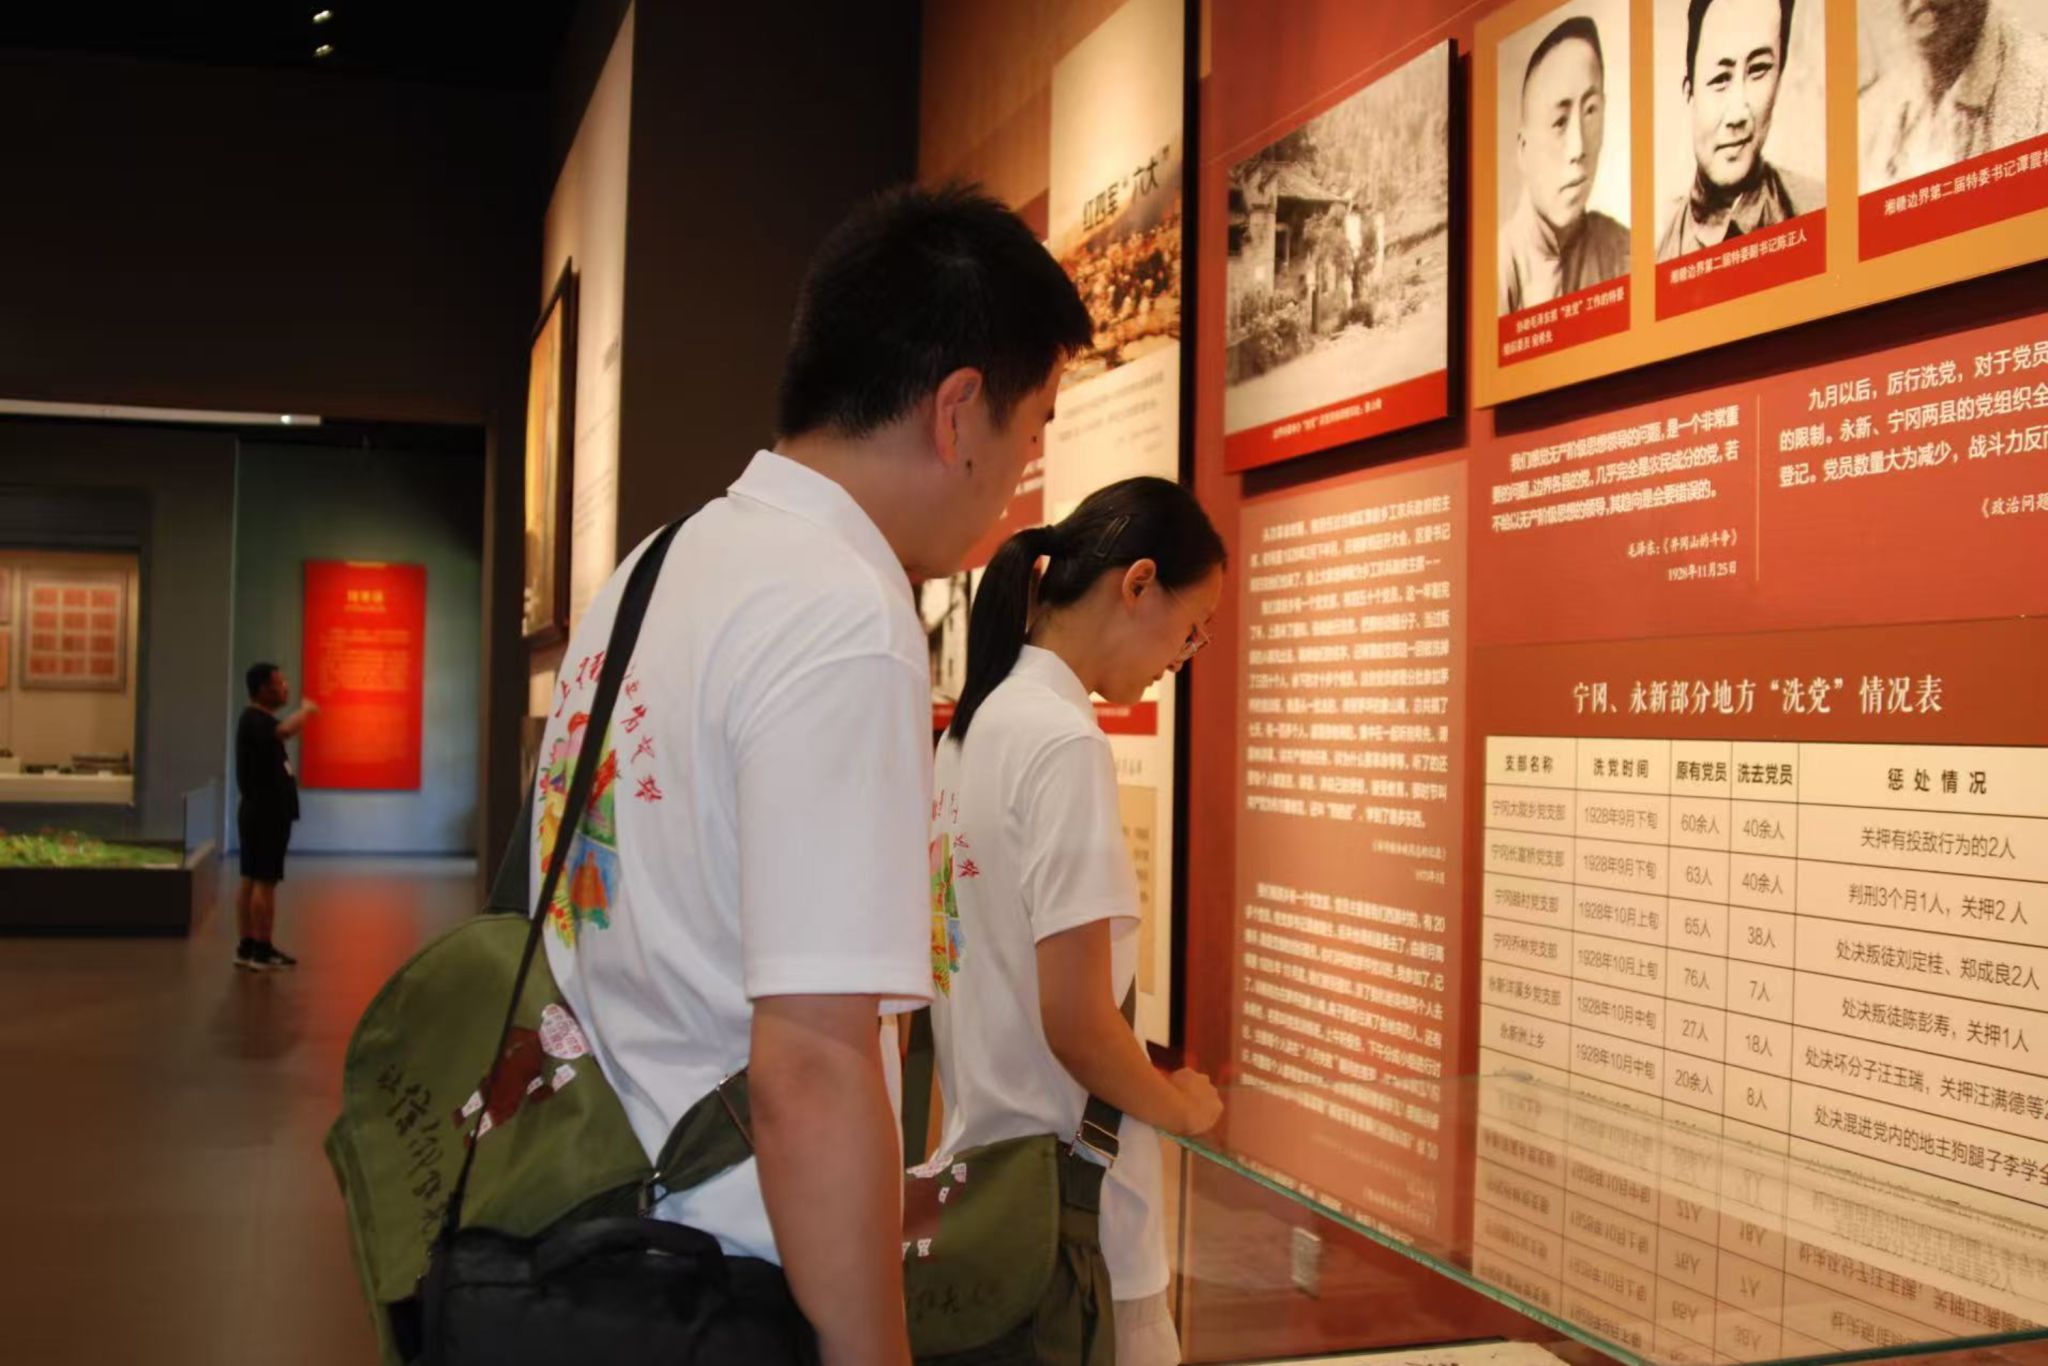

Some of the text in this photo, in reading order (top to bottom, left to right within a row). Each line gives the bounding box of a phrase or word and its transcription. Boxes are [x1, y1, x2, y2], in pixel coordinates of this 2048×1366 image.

[1808, 340, 2048, 411] 九月以后，厉行洗党，对于党员
[1779, 382, 2048, 452] 的限制。永新、宁冈两县的党组织全
[1981, 492, 2048, 518] 《政治问题
[1505, 754, 1553, 774] 支部名称
[1593, 758, 1649, 779] 洗党时间
[1676, 760, 1727, 783] 原有党员
[1737, 762, 1793, 786] 洗去党员
[1888, 768, 1987, 795] 惩处情况
[1584, 807, 1658, 830] 1928年9月下旬
[1681, 814, 1719, 835] 60余人
[1743, 819, 1785, 841] 40余人
[1861, 826, 2016, 860] 关押有投敌行为的2人
[1583, 854, 1656, 880] 1928年9月下旬
[1686, 866, 1712, 886] 63人
[1741, 873, 1783, 895] 40余人
[1579, 902, 1659, 930] 1928年10月上旬
[1685, 917, 1711, 939] 65人
[1747, 926, 1776, 949] 38人
[1578, 949, 1658, 981] 1928年10月上旬
[1836, 938, 2040, 991] 处决叛徒刘定桂、郑成良2人
[1684, 968, 1710, 990] 76人
[1749, 980, 1771, 1002] 7人
[1577, 996, 1656, 1031] 1928年10月中旬
[1842, 997, 2030, 1053] 处决叛徒陈彭寿，关押1人
[1682, 1019, 1709, 1042] 27人
[1745, 1034, 1773, 1057] 18人
[1576, 1043, 1655, 1081] 1928年10月中旬
[1675, 1069, 1714, 1096] 20余人
[1746, 1088, 1767, 1111] 8人
